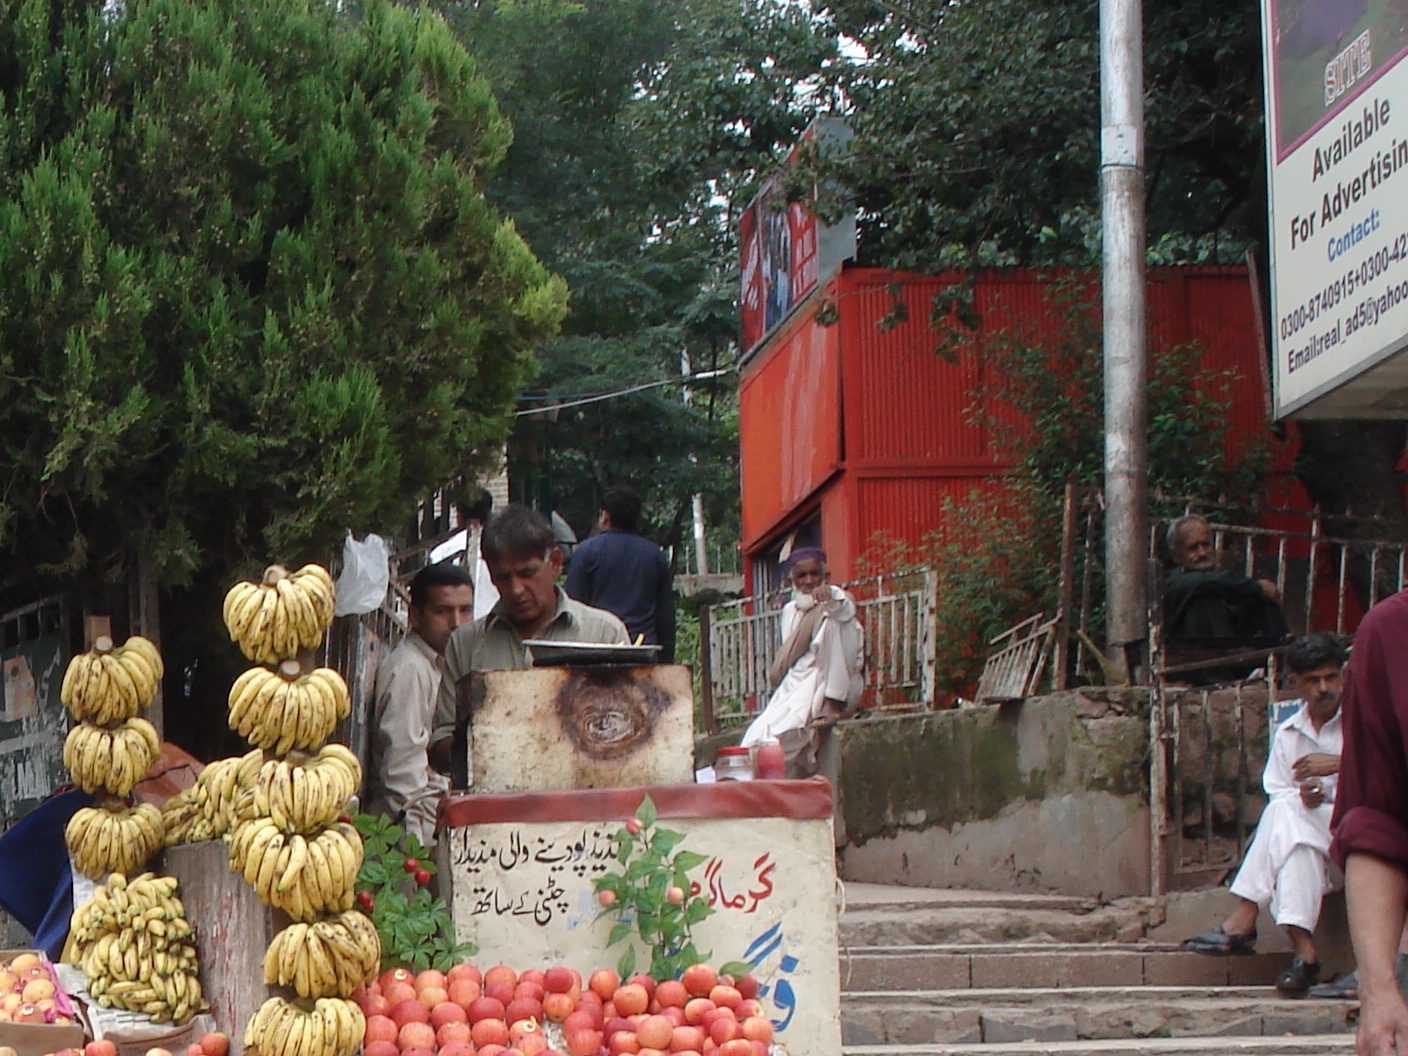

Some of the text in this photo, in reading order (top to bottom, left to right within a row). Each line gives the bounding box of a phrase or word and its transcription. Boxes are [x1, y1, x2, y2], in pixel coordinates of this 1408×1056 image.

[1323, 28, 1372, 108] SITE
[1311, 97, 1391, 183] Available
[1290, 209, 1317, 251] For
[1327, 208, 1381, 263] Contact:
[1280, 231, 1408, 341] 0300-8740915+0300-42
